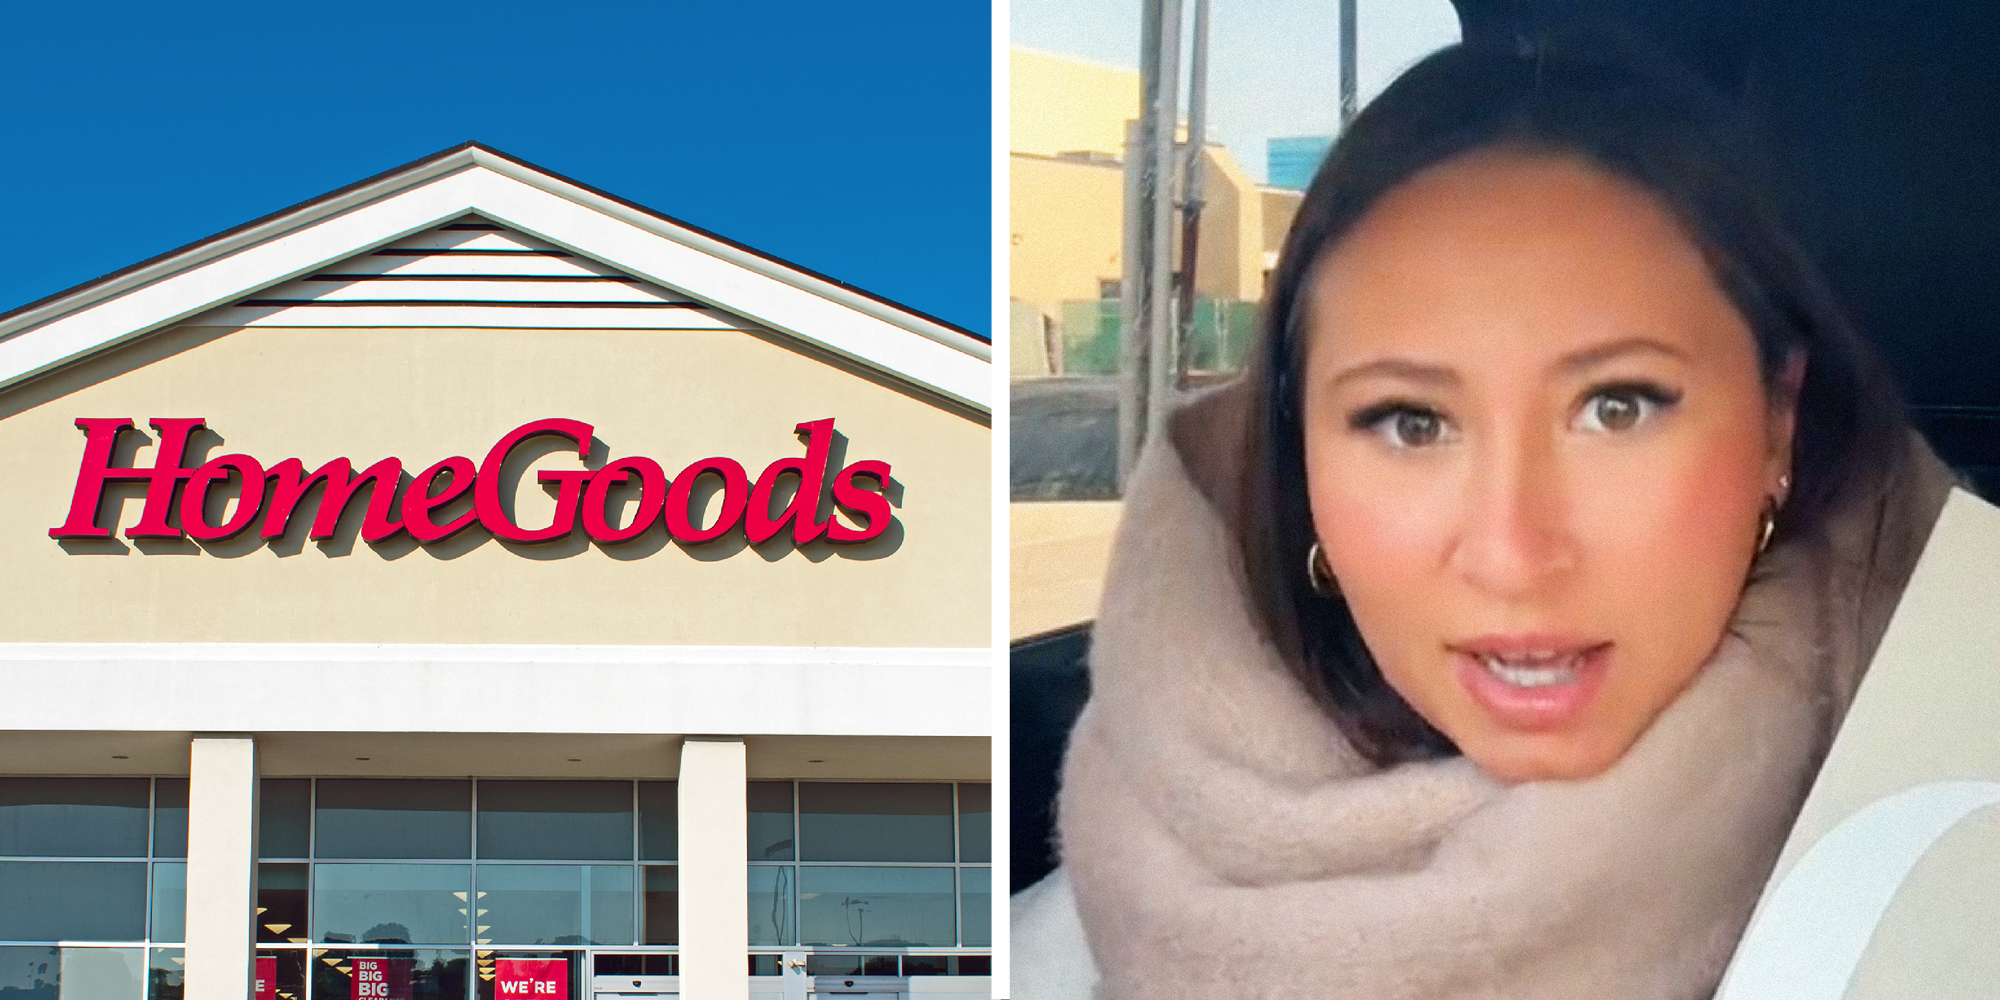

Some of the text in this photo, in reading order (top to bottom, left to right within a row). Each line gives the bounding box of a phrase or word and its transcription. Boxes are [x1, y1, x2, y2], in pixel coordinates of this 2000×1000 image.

[48, 417, 892, 541] HomeGoods
[359, 961, 378, 970] BIG
[359, 971, 383, 981] BIG
[358, 982, 390, 997] BIG
[500, 978, 556, 993] WE'RE
